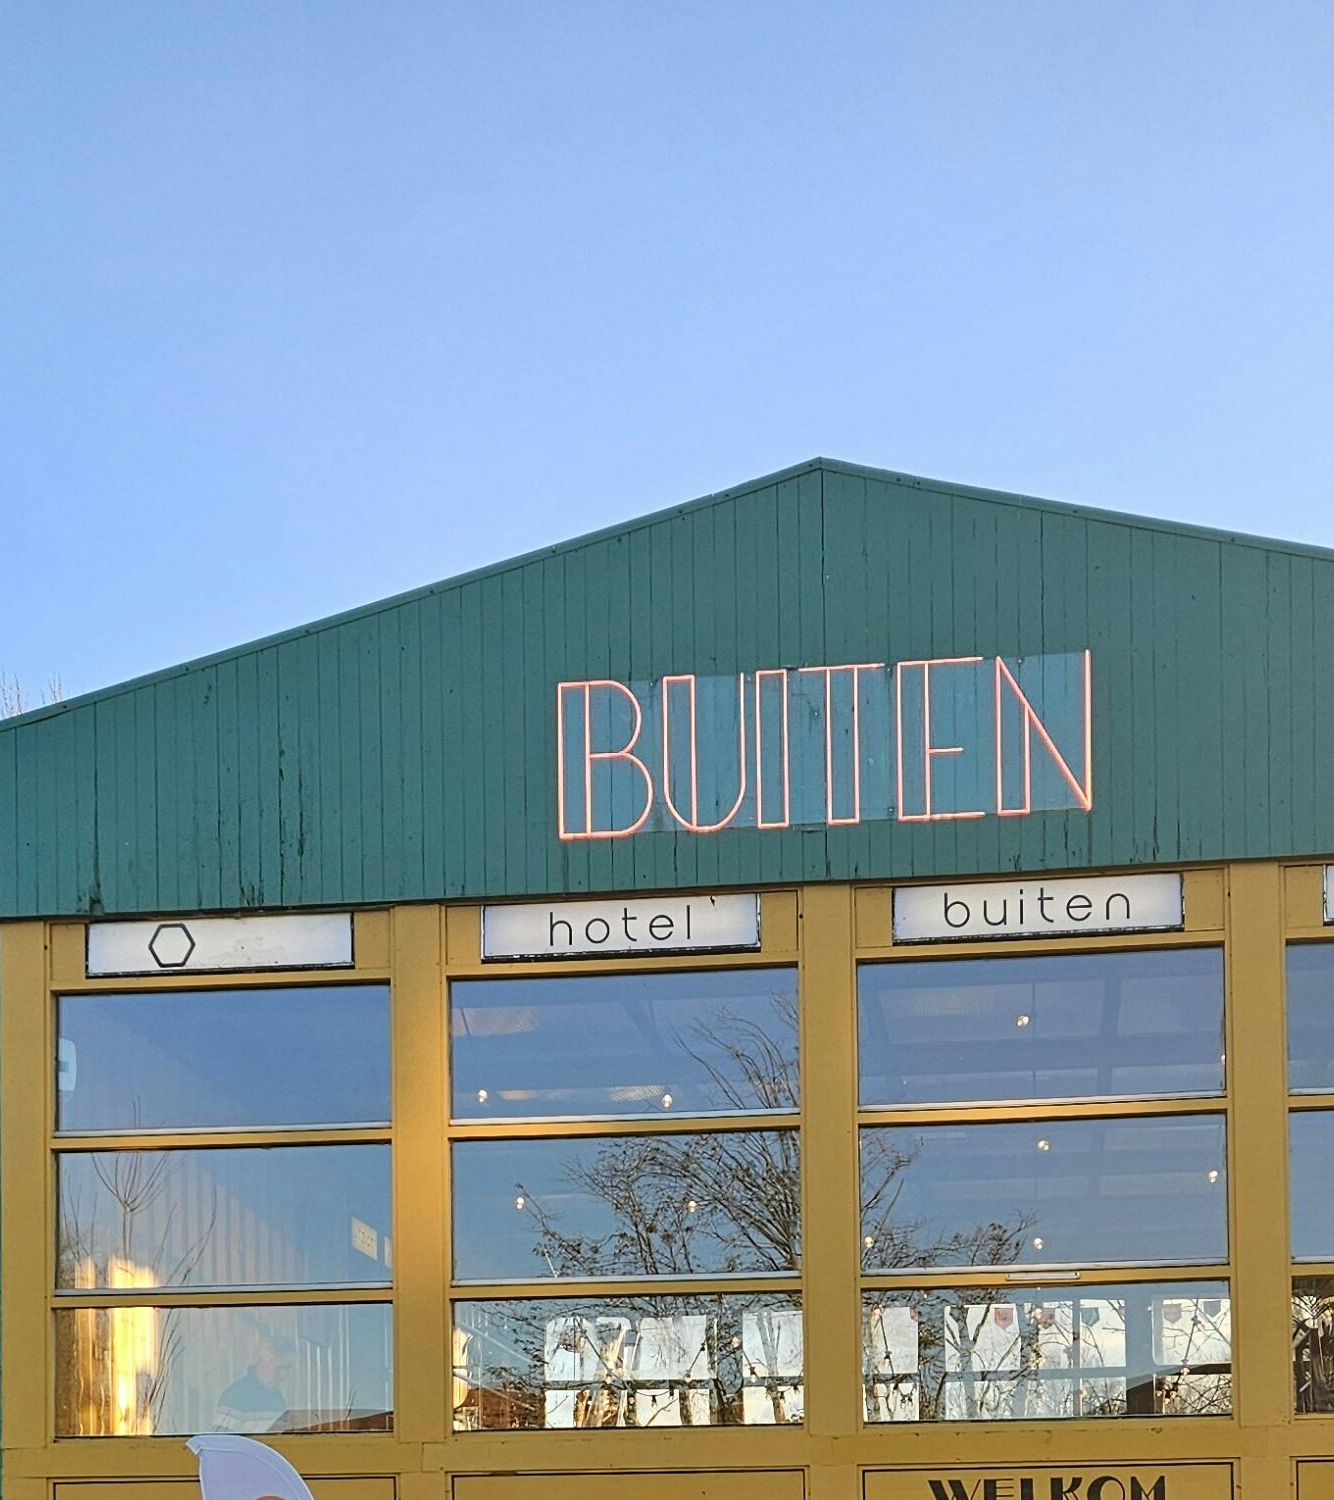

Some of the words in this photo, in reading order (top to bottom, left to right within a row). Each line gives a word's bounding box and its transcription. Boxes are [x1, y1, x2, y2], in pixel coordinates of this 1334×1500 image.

[557, 649, 1092, 841] BUITEN
[548, 904, 692, 947] hotel
[943, 887, 1131, 928] buiten
